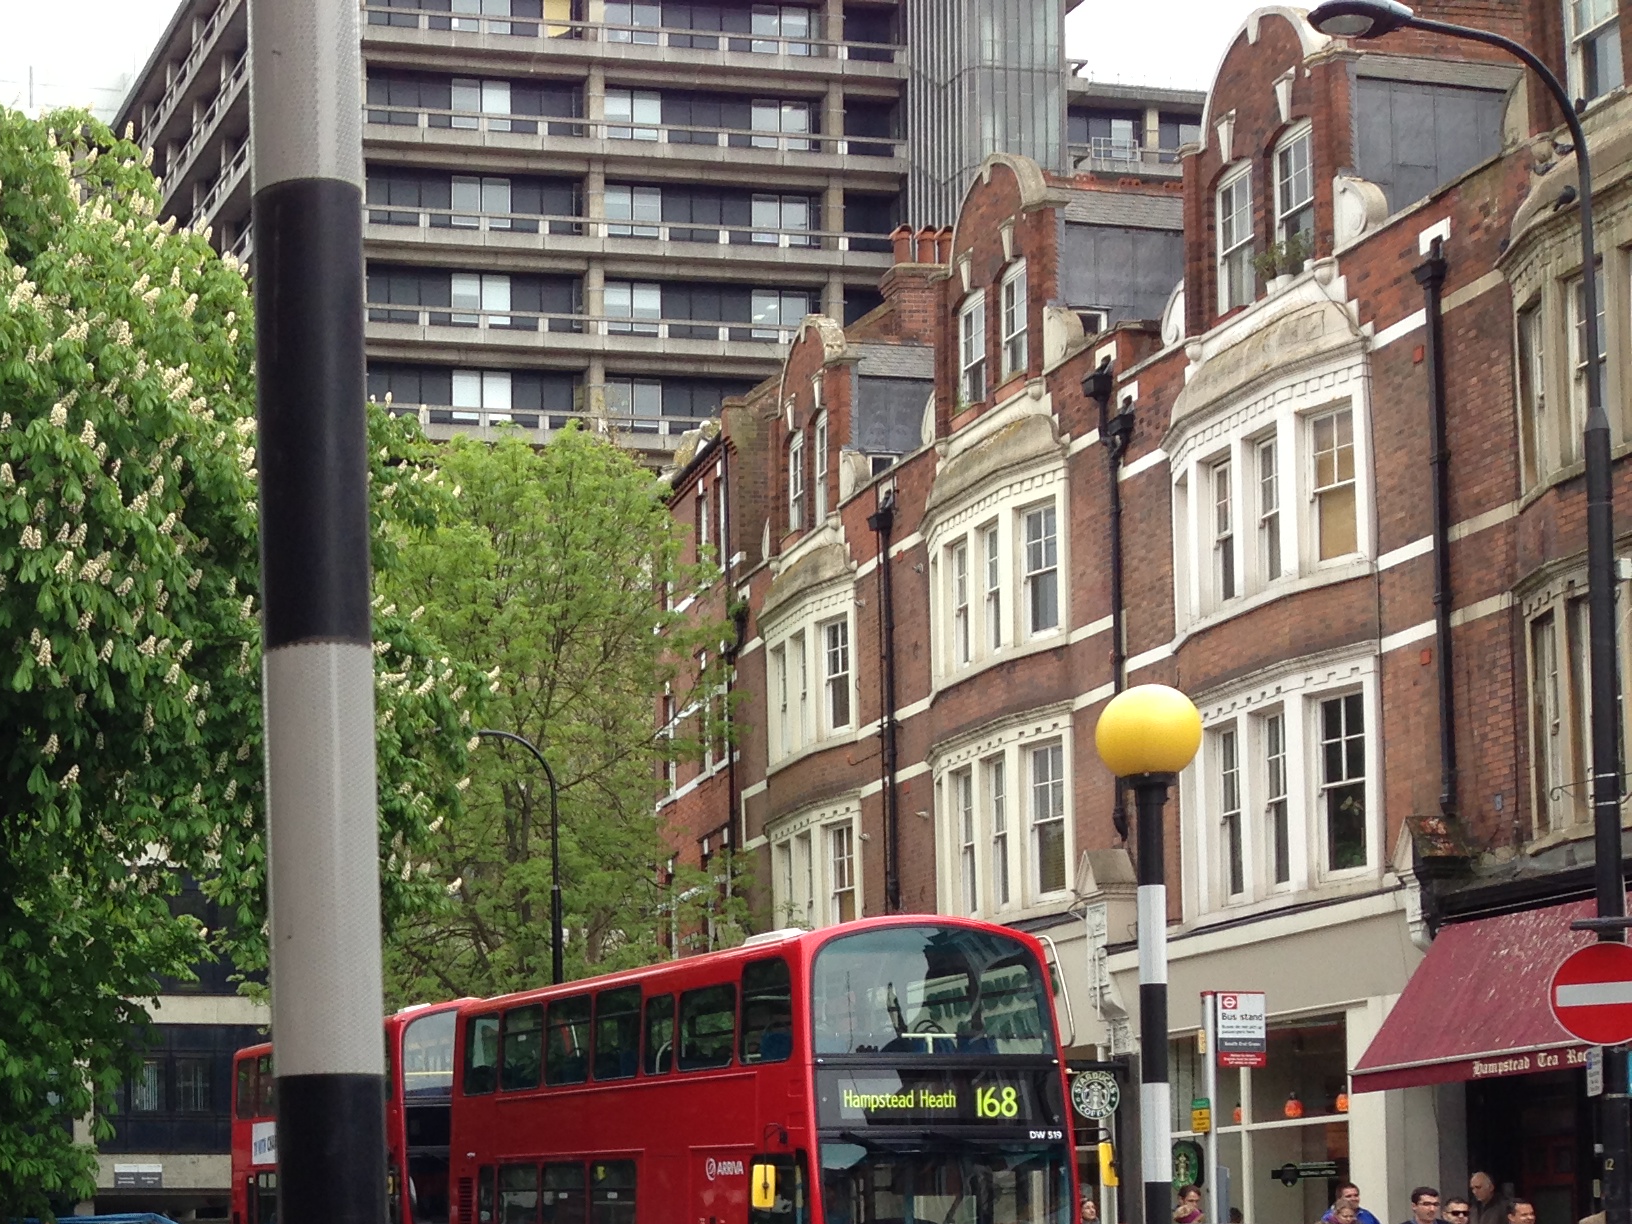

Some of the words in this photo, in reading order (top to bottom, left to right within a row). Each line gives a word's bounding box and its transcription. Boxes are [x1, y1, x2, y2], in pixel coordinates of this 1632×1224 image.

[1472, 1056, 1530, 1077] Hampstead
[1537, 1052, 1559, 1067] Tea
[843, 1089, 914, 1112] Hampstead
[920, 1089, 957, 1108] Heath
[976, 1086, 1018, 1117] 168
[1029, 1130, 1045, 1139] DW
[1047, 1130, 1063, 1139] 519
[717, 1161, 744, 1175] ARRIVA
